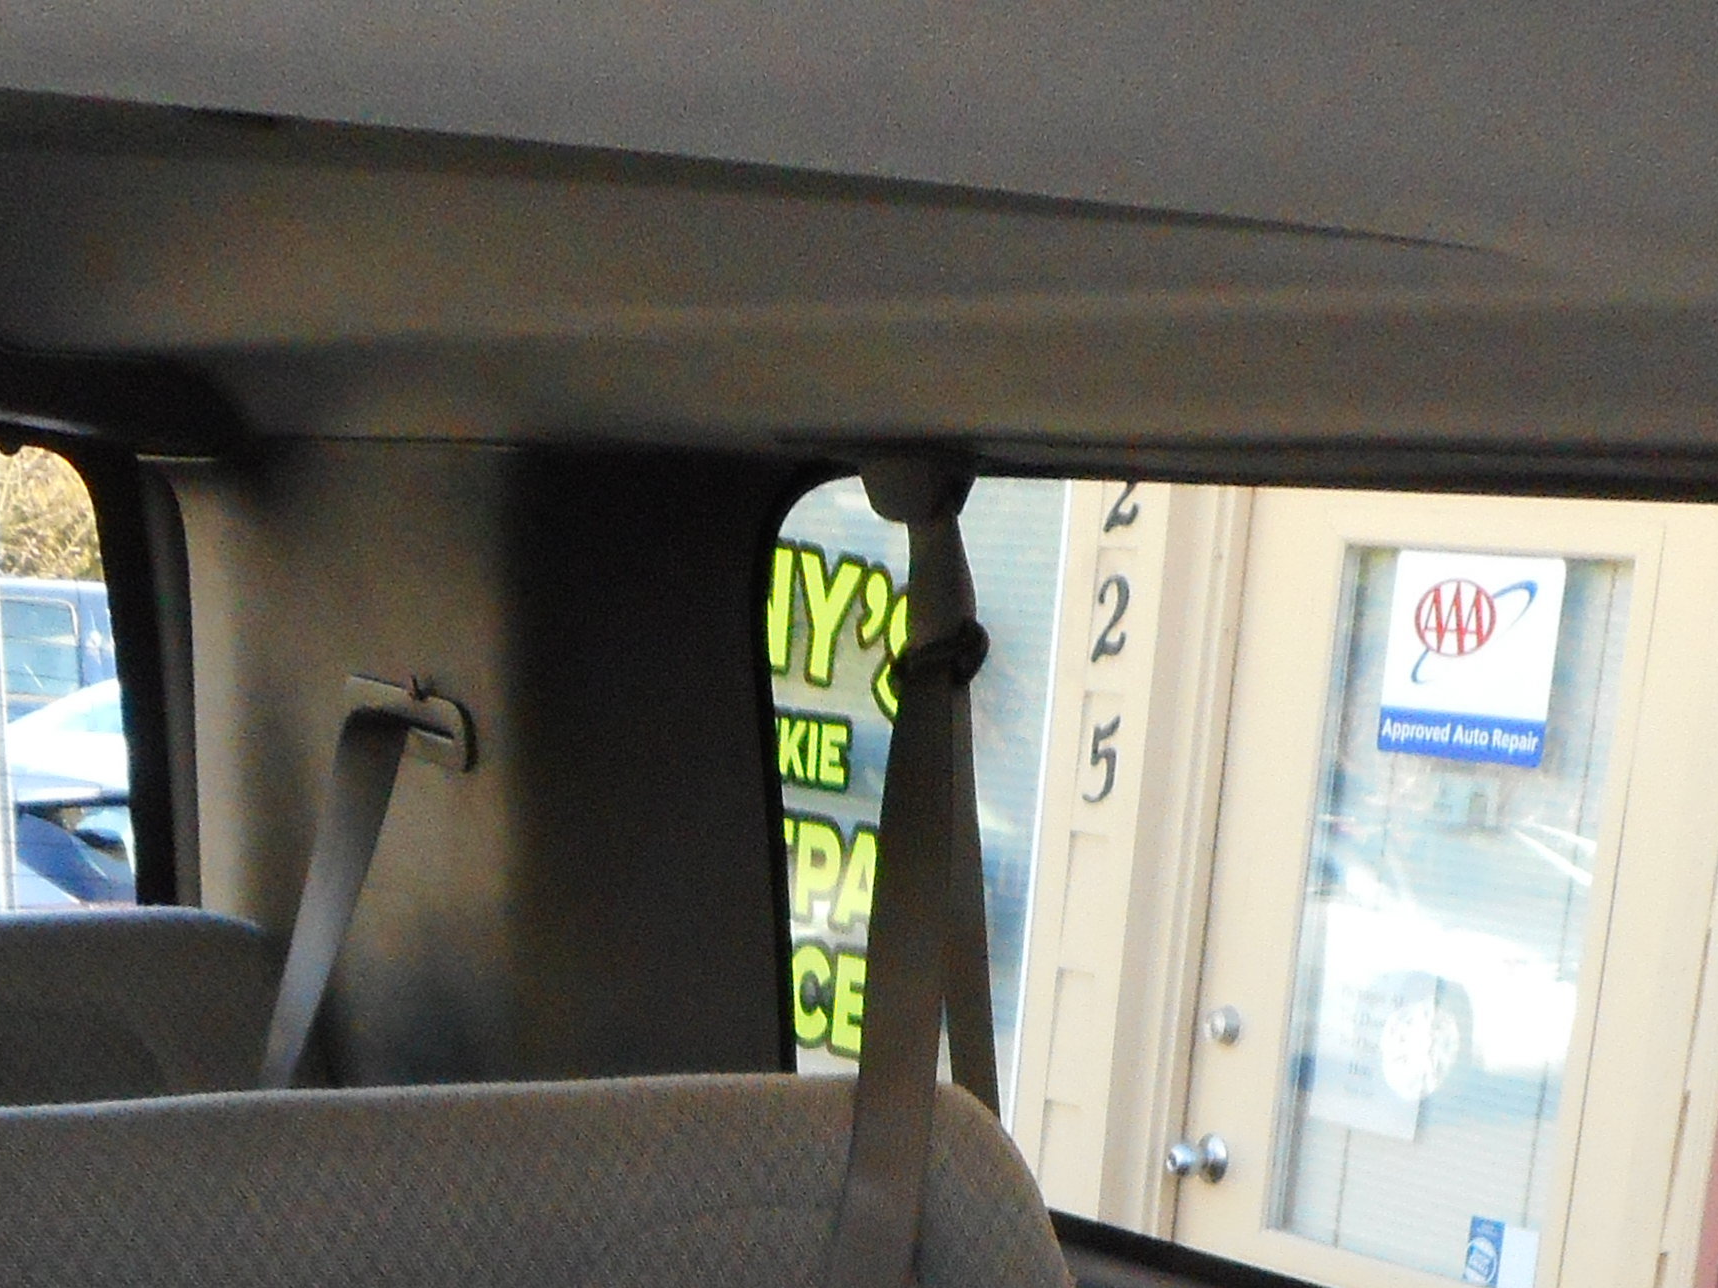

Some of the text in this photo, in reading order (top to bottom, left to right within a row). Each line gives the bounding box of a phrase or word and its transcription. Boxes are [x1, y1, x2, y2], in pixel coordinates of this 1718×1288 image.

[1421, 579, 1486, 656] AAA
[775, 717, 848, 786] KIE
[1381, 717, 1539, 754] Approved Auto Repair
